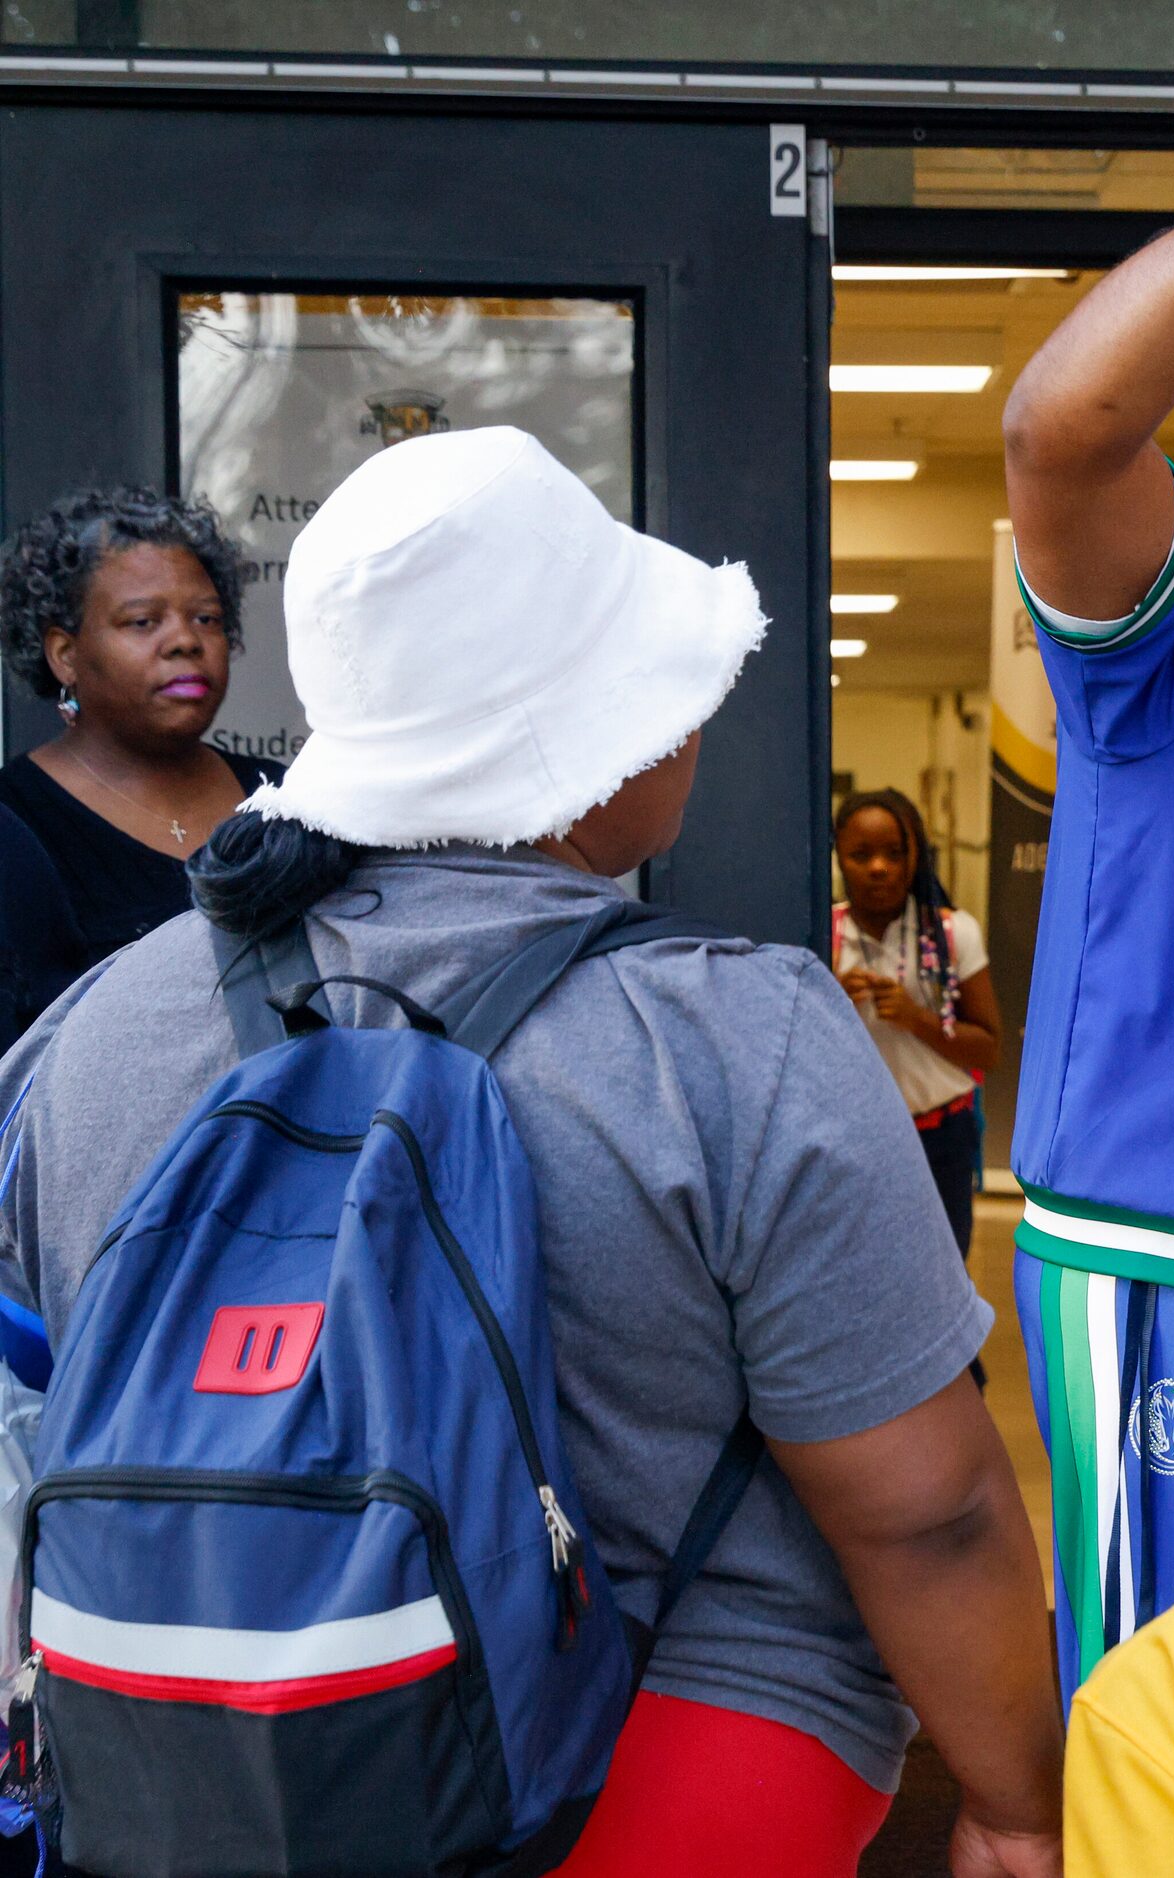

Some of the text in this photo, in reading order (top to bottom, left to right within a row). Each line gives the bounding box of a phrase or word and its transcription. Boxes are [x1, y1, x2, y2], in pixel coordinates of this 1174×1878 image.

[775, 142, 801, 197] 2
[250, 493, 320, 521] Atte
[212, 727, 307, 757] Stude
